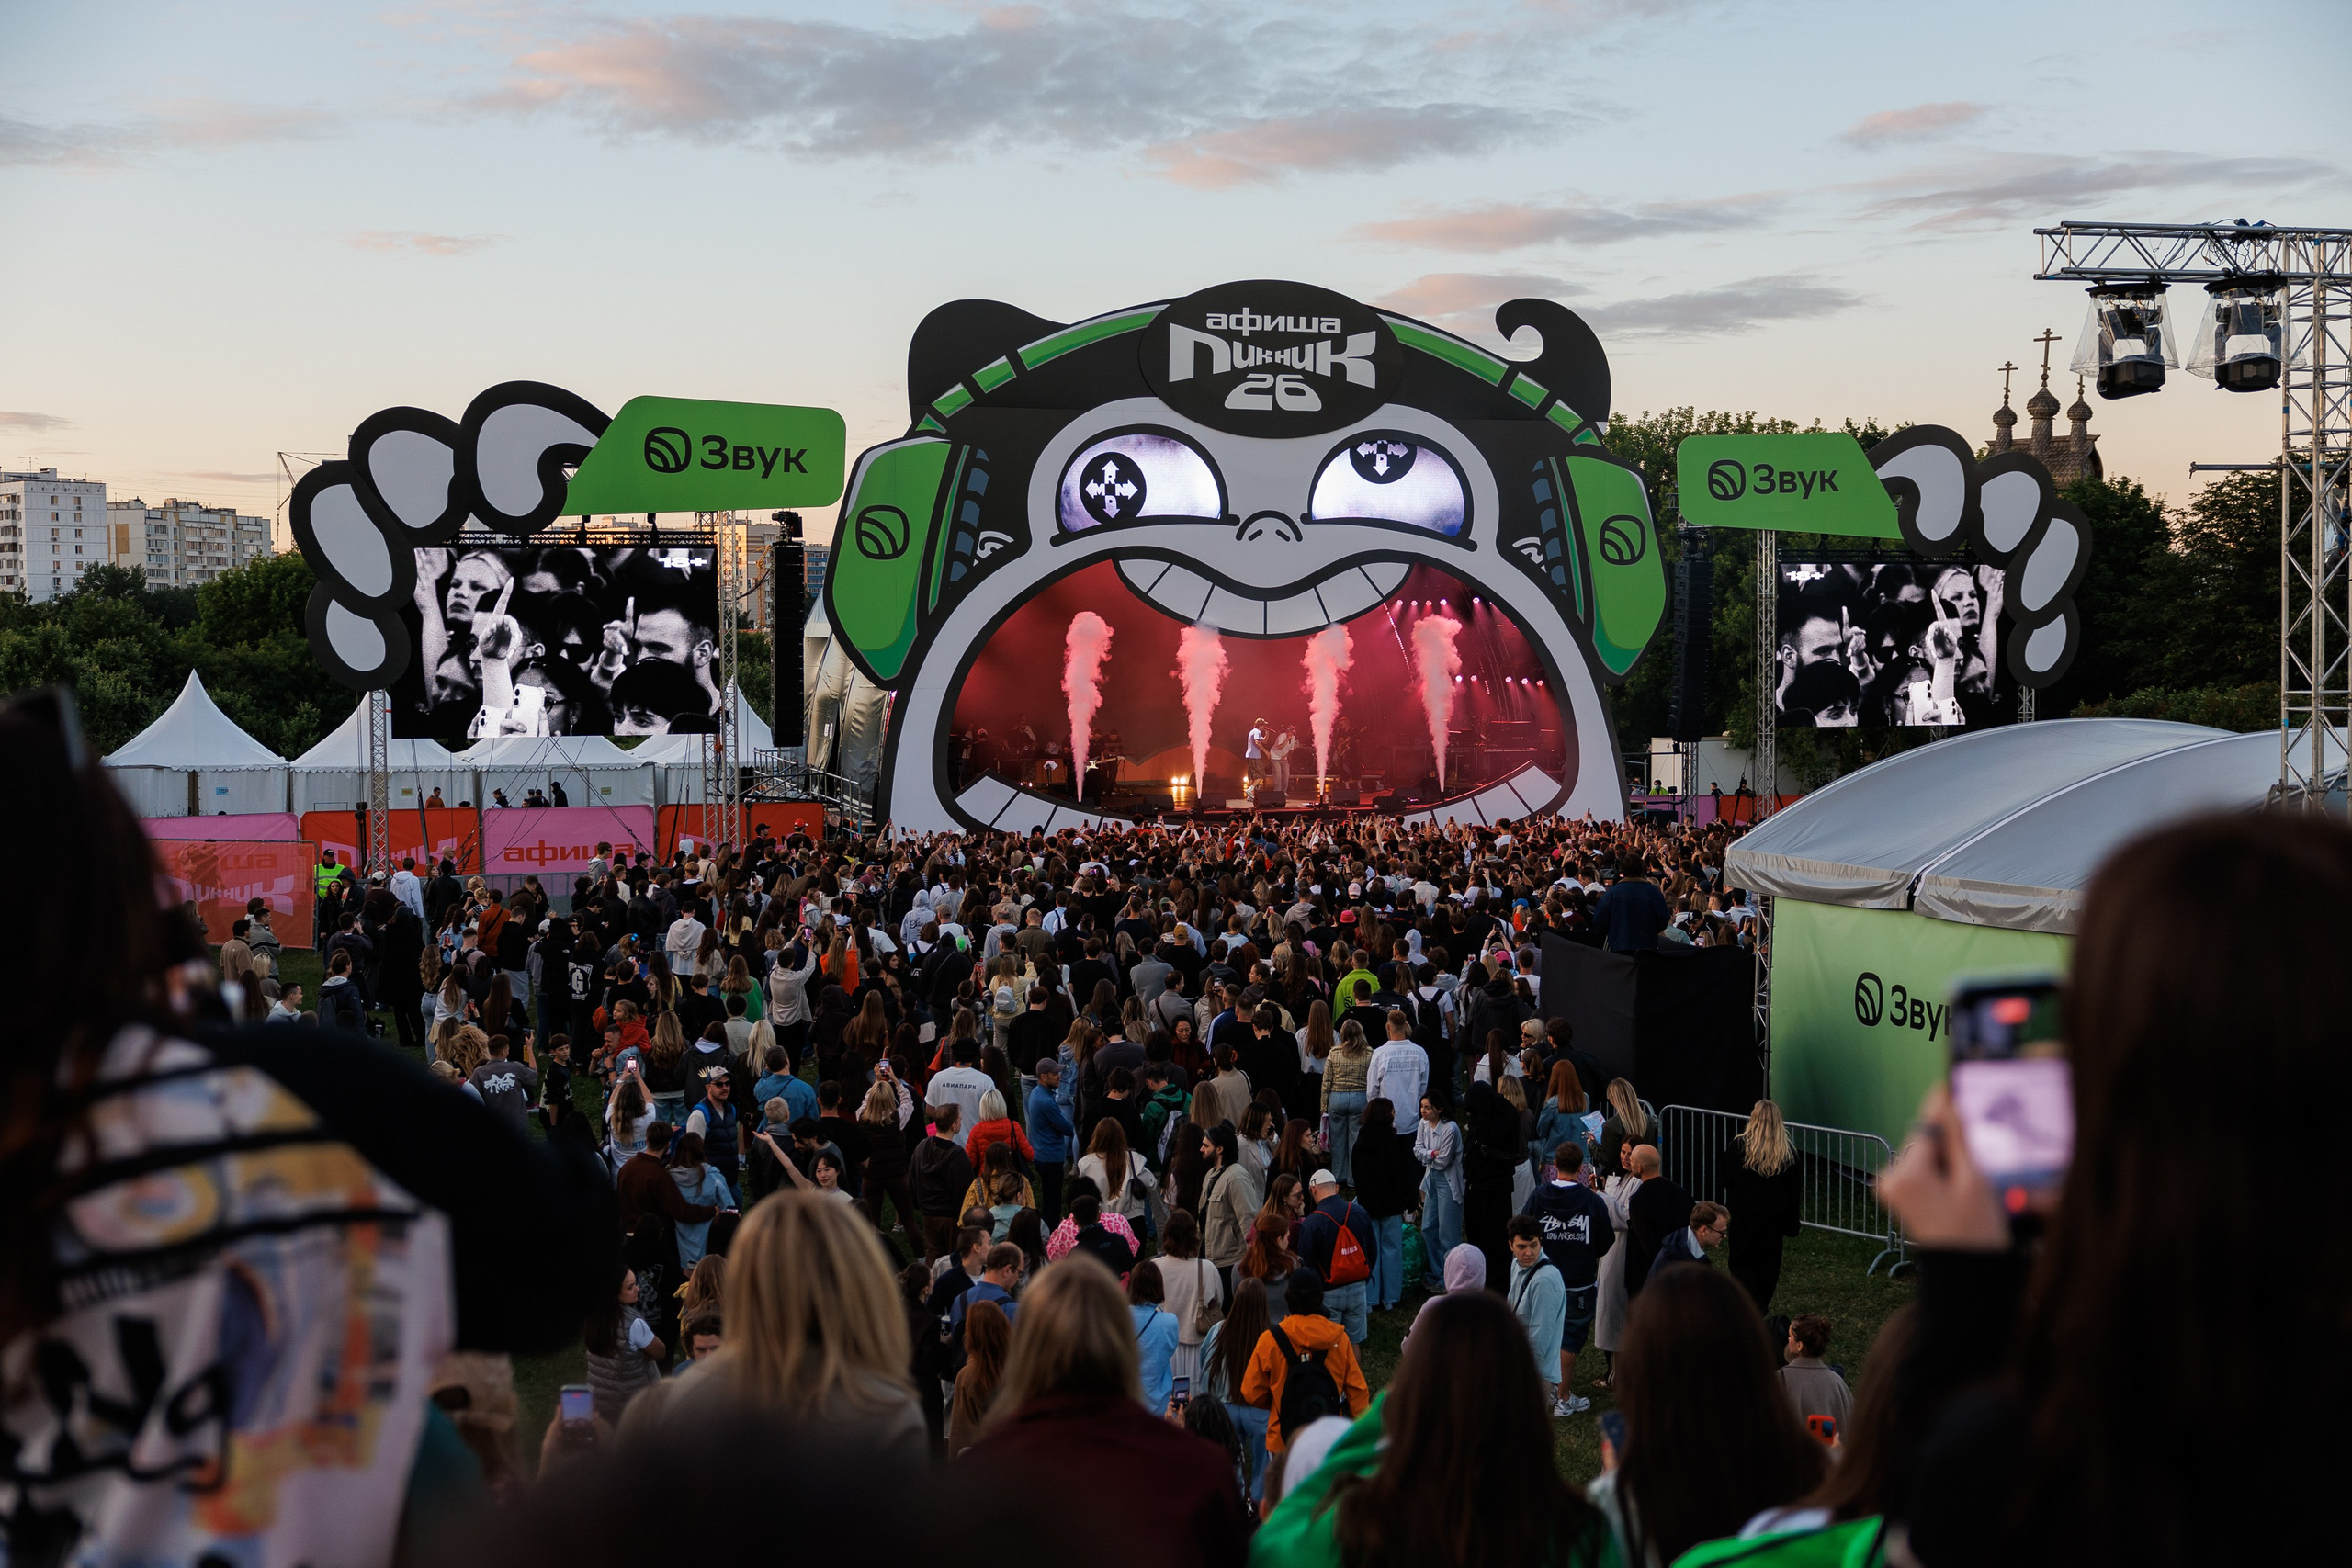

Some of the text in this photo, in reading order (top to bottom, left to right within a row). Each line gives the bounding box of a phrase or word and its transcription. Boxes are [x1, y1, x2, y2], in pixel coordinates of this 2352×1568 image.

[1206, 307, 1341, 336] афиша
[1224, 373, 1322, 412] 26
[700, 435, 808, 479] Звук
[1753, 463, 1839, 500] Звук
[658, 557, 707, 568] 18+
[1785, 570, 1825, 581] 18+
